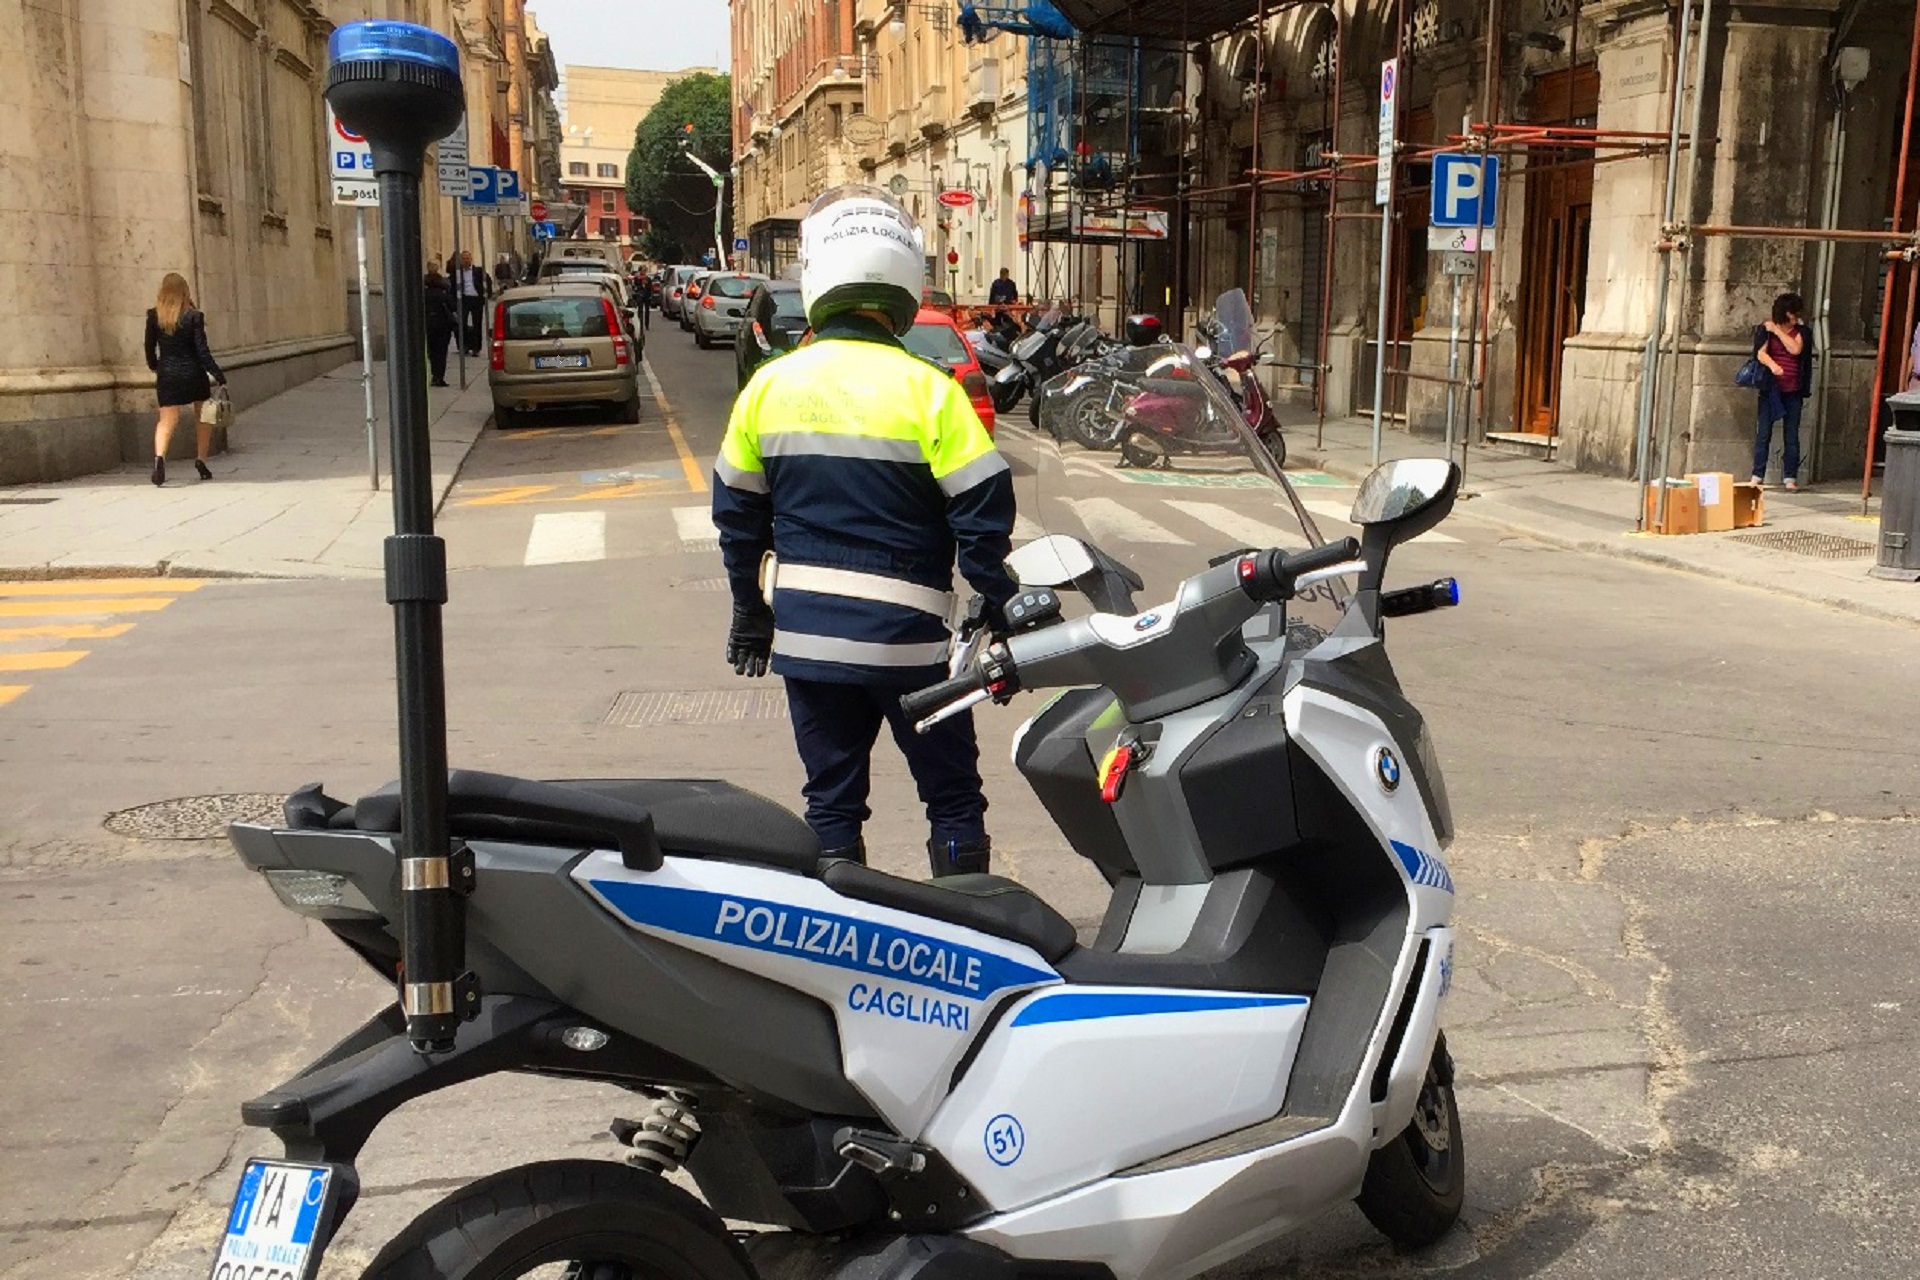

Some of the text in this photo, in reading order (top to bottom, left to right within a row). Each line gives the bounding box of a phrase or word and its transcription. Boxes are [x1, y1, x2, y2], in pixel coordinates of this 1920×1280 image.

[340, 153, 352, 166] P
[468, 171, 489, 200] P
[497, 172, 514, 195] P
[1446, 161, 1482, 218] P
[823, 226, 914, 250] POLIZIA LOCALE
[714, 899, 982, 991] POLIZIA LOCALE
[848, 983, 969, 1031] CAGLIARI
[993, 1125, 1016, 1155] 51
[254, 1170, 288, 1229] YA
[227, 1239, 300, 1266] POLIZIA LOCALE
